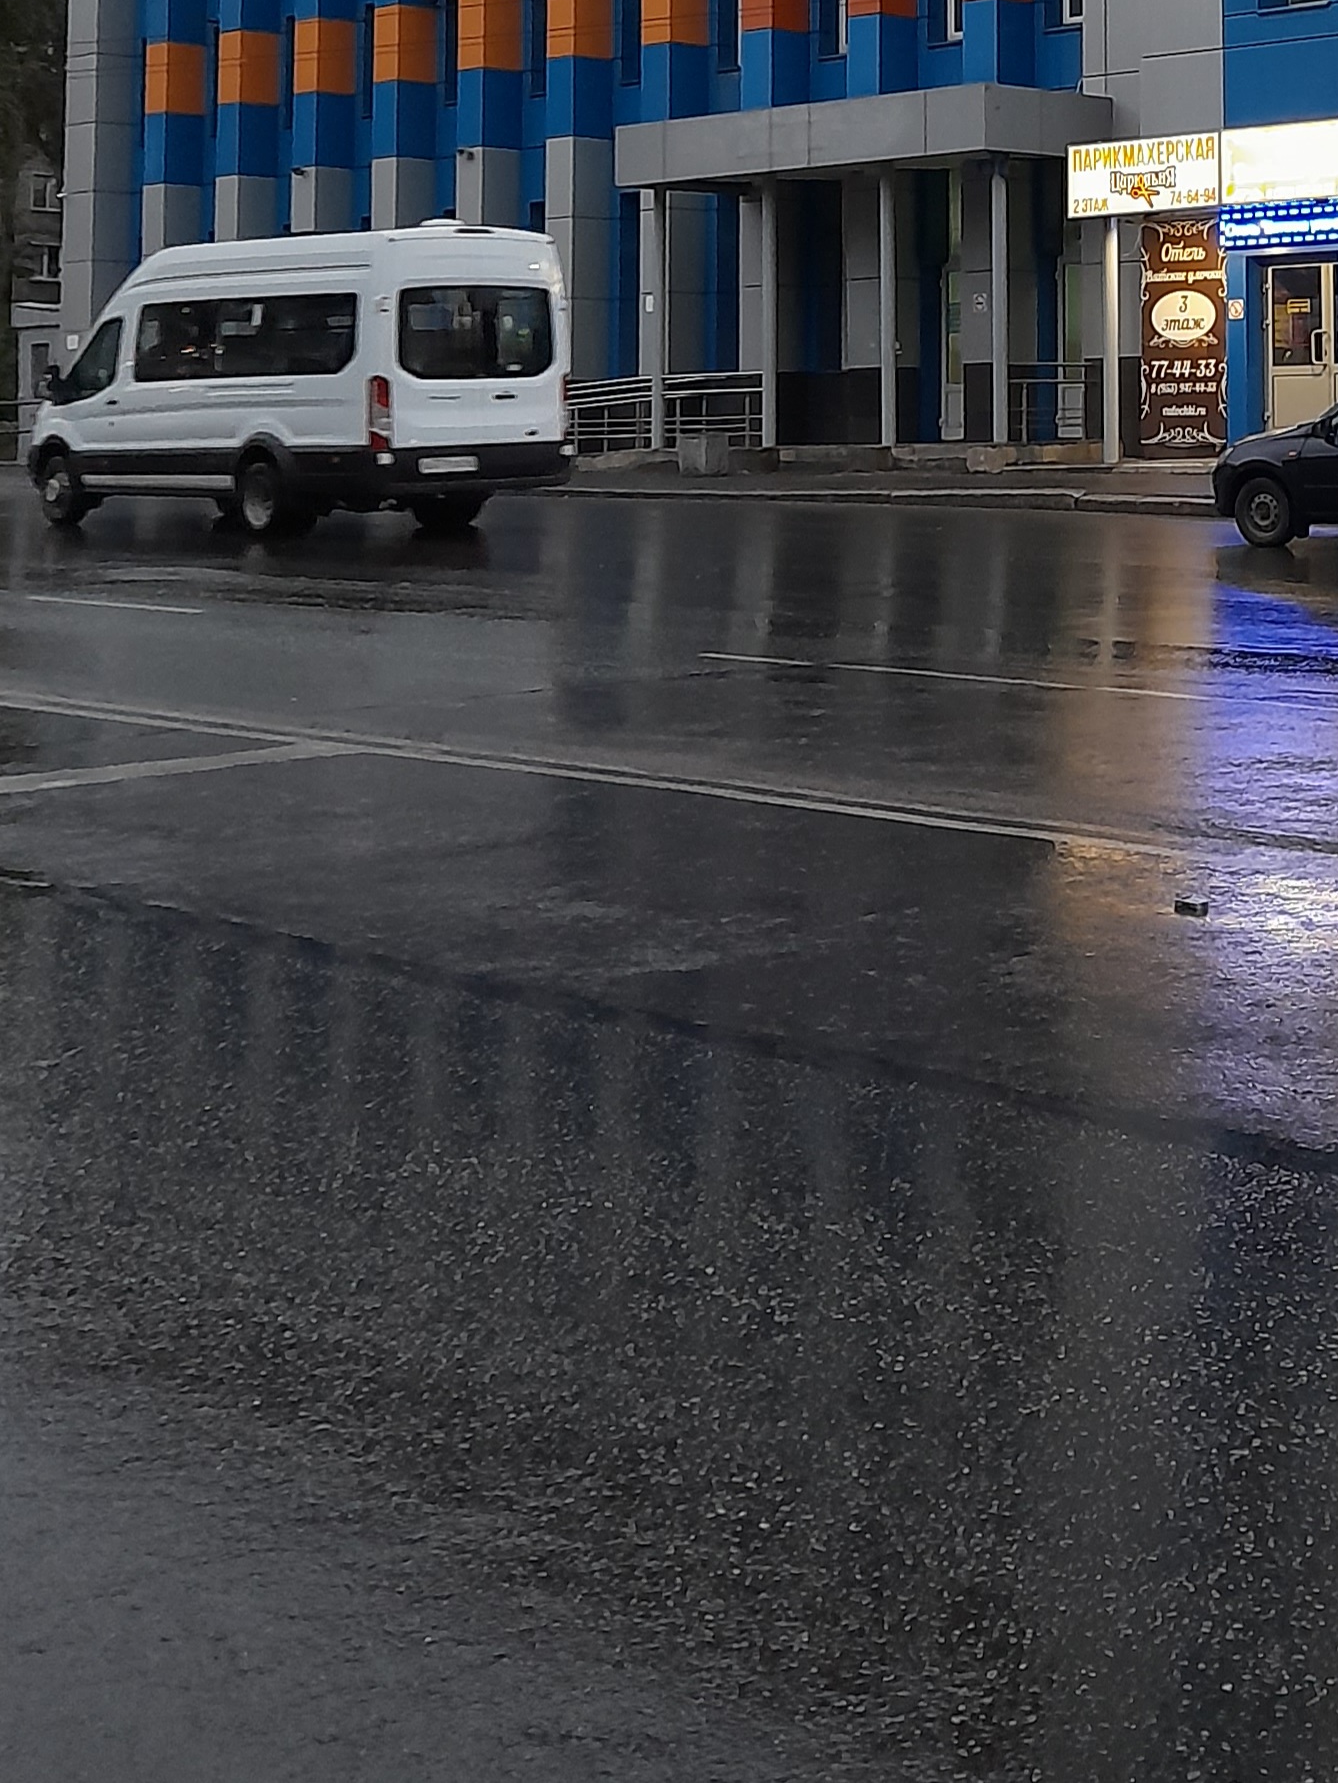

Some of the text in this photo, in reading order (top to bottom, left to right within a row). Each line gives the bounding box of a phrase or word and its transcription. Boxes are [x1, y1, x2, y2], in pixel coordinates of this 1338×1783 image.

[1073, 136, 1215, 173] ПАРИКМАХЕРСКАЯ
[1073, 187, 1216, 214] 2 ЭТАЖ 74-64-94
[1161, 240, 1206, 262] Отель
[1178, 295, 1189, 313] 3
[1161, 317, 1206, 332] этаж
[1150, 358, 1217, 379] 77-44-33
